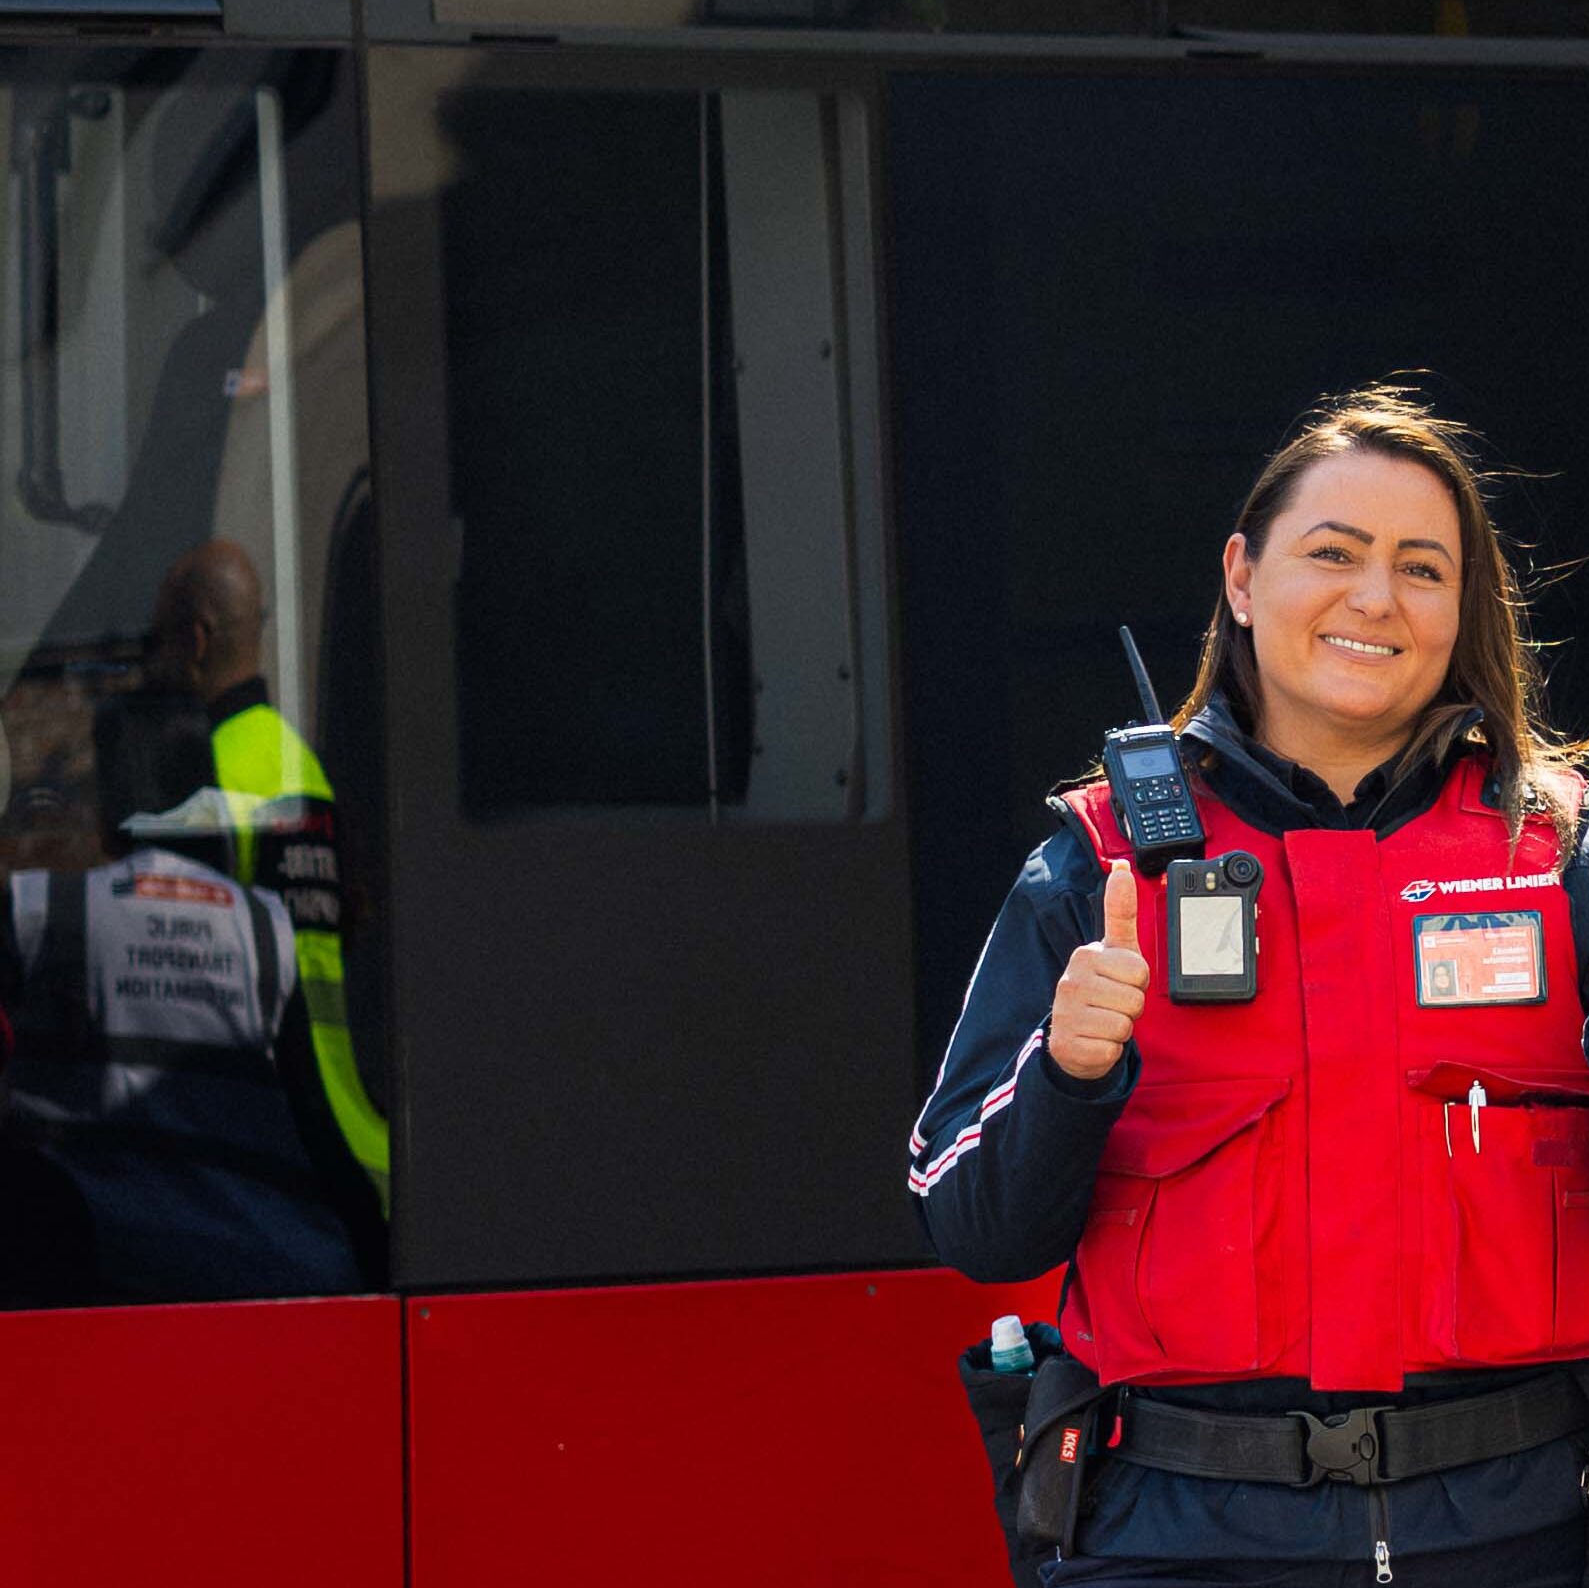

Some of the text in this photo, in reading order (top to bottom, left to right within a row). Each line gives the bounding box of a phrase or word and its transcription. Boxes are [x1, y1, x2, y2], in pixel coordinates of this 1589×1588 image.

[1437, 873, 1561, 895] WIENER LINIEN
[1062, 1431, 1078, 1459] KKS
